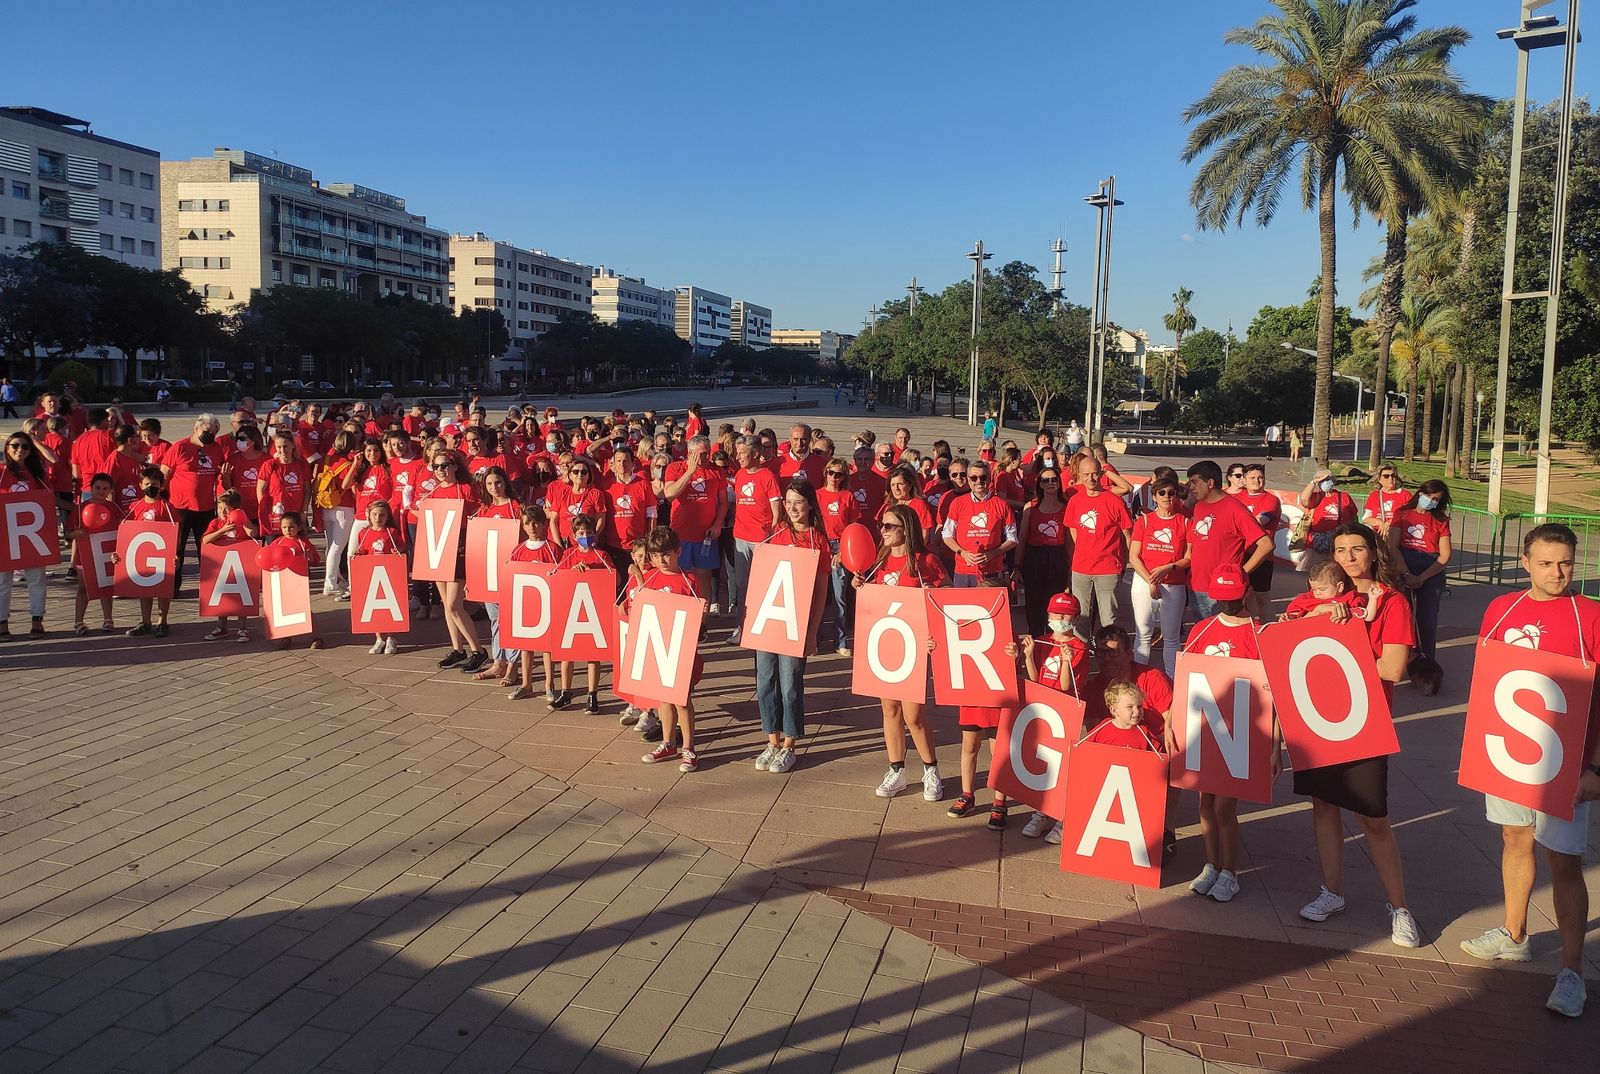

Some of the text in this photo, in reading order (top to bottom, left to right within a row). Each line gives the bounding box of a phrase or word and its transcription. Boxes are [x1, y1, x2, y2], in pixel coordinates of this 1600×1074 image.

[5, 501, 52, 560] R
[125, 531, 167, 587] G
[424, 509, 456, 570] V
[486, 529, 499, 592] I
[208, 550, 255, 607] A
[270, 571, 307, 628] L
[360, 565, 404, 623] A
[511, 573, 551, 639] D
[750, 559, 799, 642] A
[560, 582, 609, 649] A
[630, 603, 688, 689] N
[943, 604, 1006, 691] R
[1288, 636, 1369, 742] O
[1009, 702, 1066, 791] G
[1185, 671, 1250, 780] N
[1485, 669, 1568, 786] S
[1076, 764, 1152, 868] A
